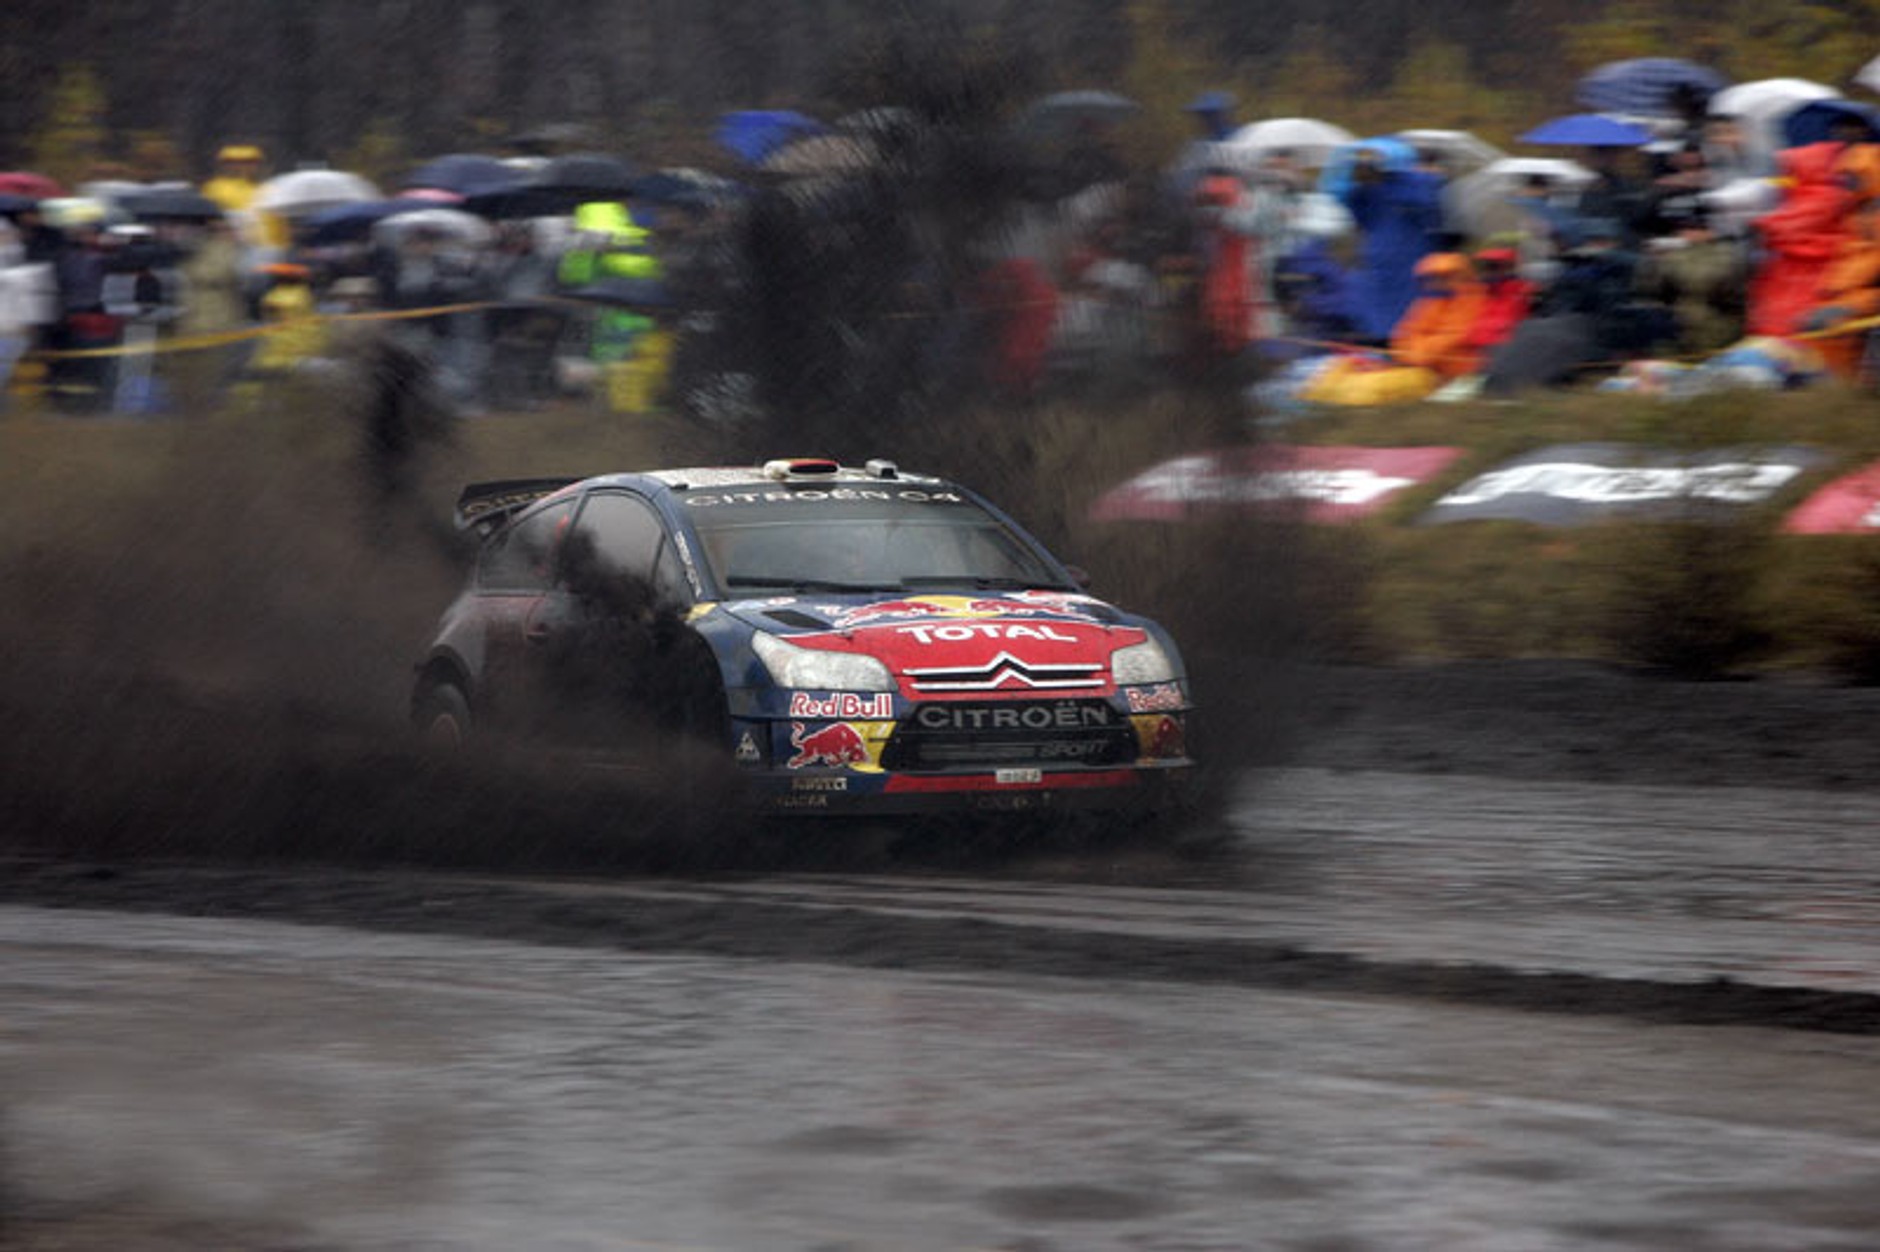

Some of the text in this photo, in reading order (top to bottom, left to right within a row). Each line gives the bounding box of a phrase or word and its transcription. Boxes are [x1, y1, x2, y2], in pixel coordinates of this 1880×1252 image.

[686, 489, 962, 506] CITROËN C4
[896, 624, 1079, 645] TOTAL
[789, 691, 892, 717] Red Bull
[918, 700, 1108, 728] CITROËN
